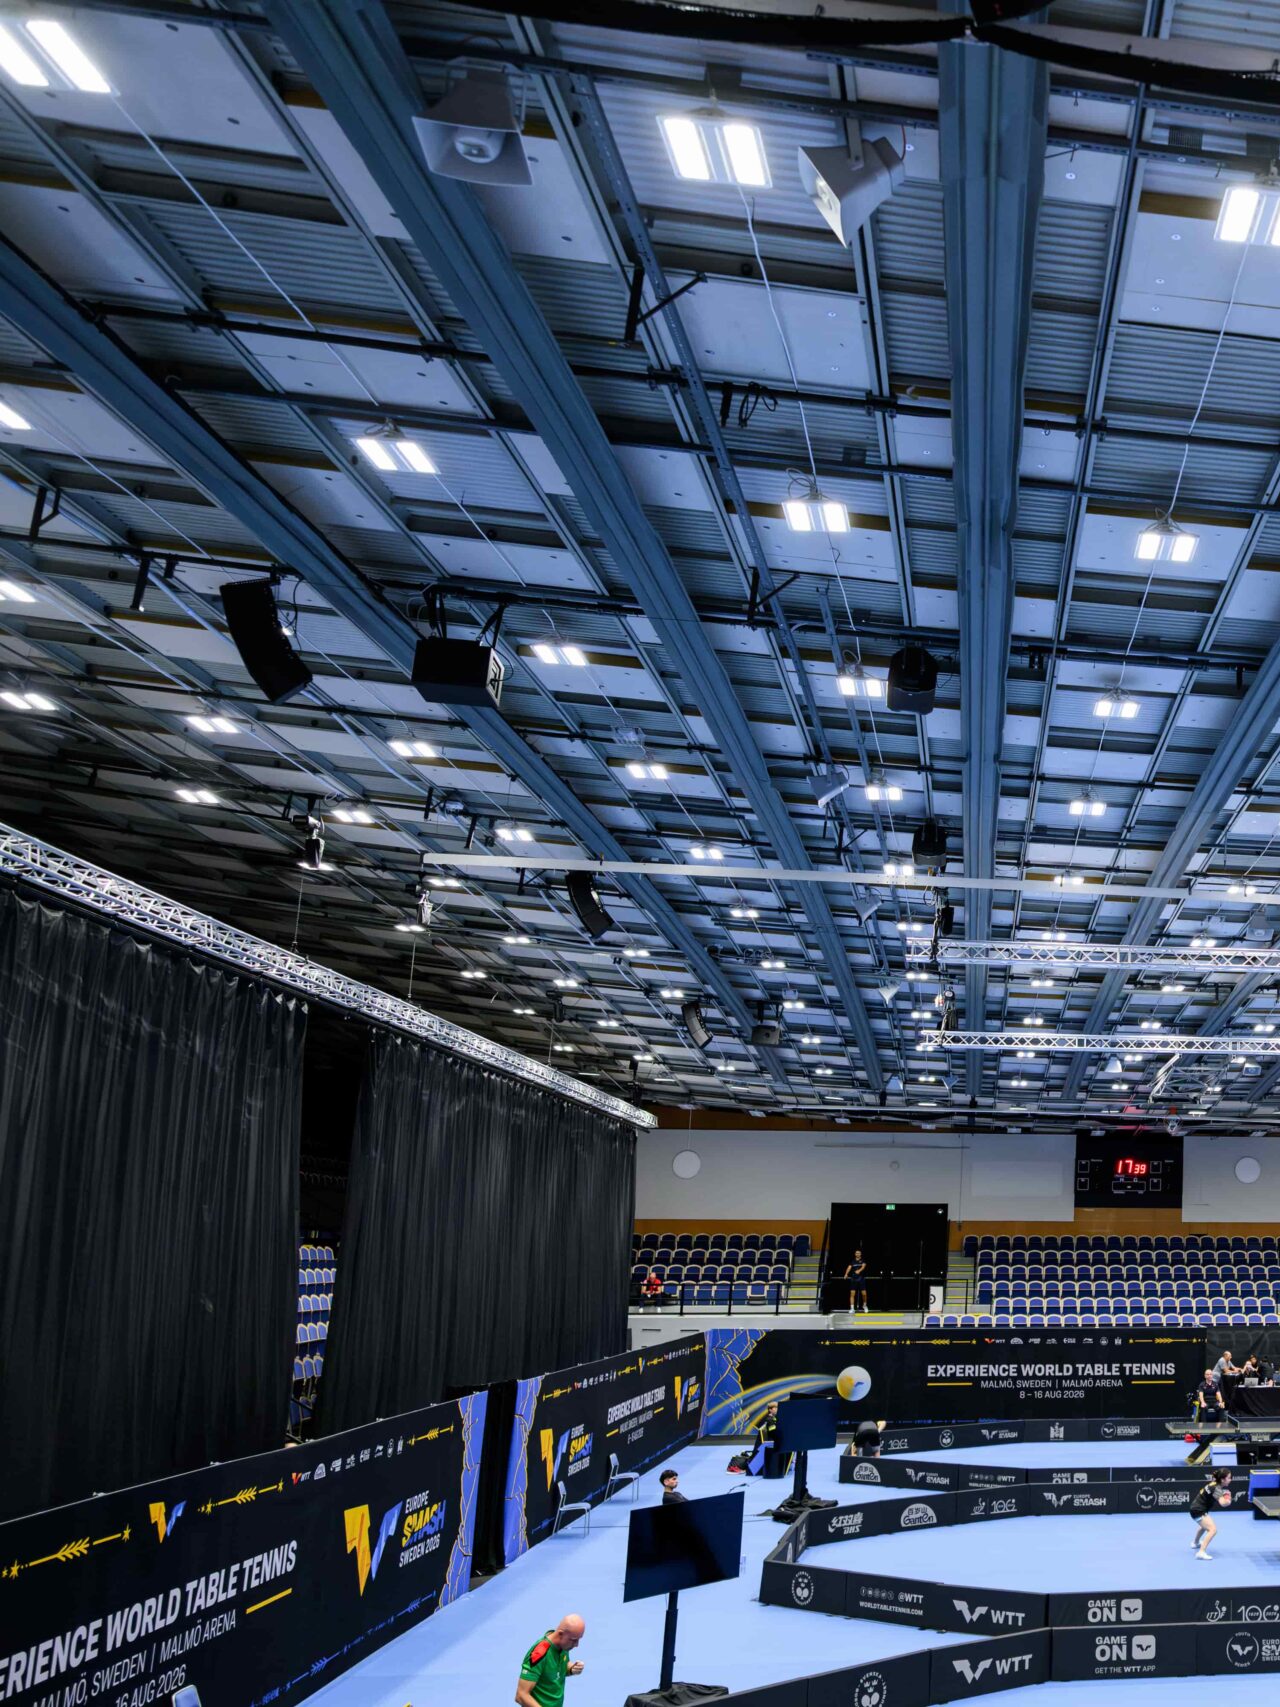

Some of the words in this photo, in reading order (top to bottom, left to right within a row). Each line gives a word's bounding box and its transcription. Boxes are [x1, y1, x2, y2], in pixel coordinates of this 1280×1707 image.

[927, 1364, 1018, 1377] EXPERIENCE
[1021, 1364, 1073, 1377] WORLD
[1076, 1363, 1120, 1376] TABLE
[1123, 1362, 1175, 1376] TENNIS
[980, 1378, 1015, 1389] MALMÖ,
[1017, 1379, 1052, 1388] SWEDEN
[1062, 1378, 1093, 1388] MALMÖ
[1095, 1379, 1123, 1387] ARENA
[1019, 1391, 1025, 1399] 8
[1063, 1390, 1085, 1398] 2026
[926, 1477, 949, 1485] SMASH
[405, 1490, 430, 1514] EUROPE
[1073, 1498, 1106, 1506] SMASH
[402, 1500, 446, 1548] SMASH
[399, 1541, 425, 1568] SWEDEN
[425, 1533, 440, 1554] 2026
[106, 1588, 181, 1652] WORLD
[185, 1564, 240, 1617] TABLE
[242, 1539, 298, 1592] TENNIS
[898, 1592, 923, 1604] @WTT
[1088, 1600, 1117, 1608] GAME
[991, 1610, 1026, 1626] WTT
[1087, 1608, 1117, 1622] ON
[1095, 1636, 1127, 1645] GAME
[91, 1650, 147, 1697] SWEDEN
[160, 1619, 202, 1664] MALMÖ
[202, 1609, 236, 1643] ARENA
[1095, 1645, 1127, 1661] ON
[996, 1654, 1033, 1676] WTT
[1123, 1665, 1141, 1673] WTT
[130, 1679, 156, 1707] AUG
[156, 1663, 186, 1698] 2026
